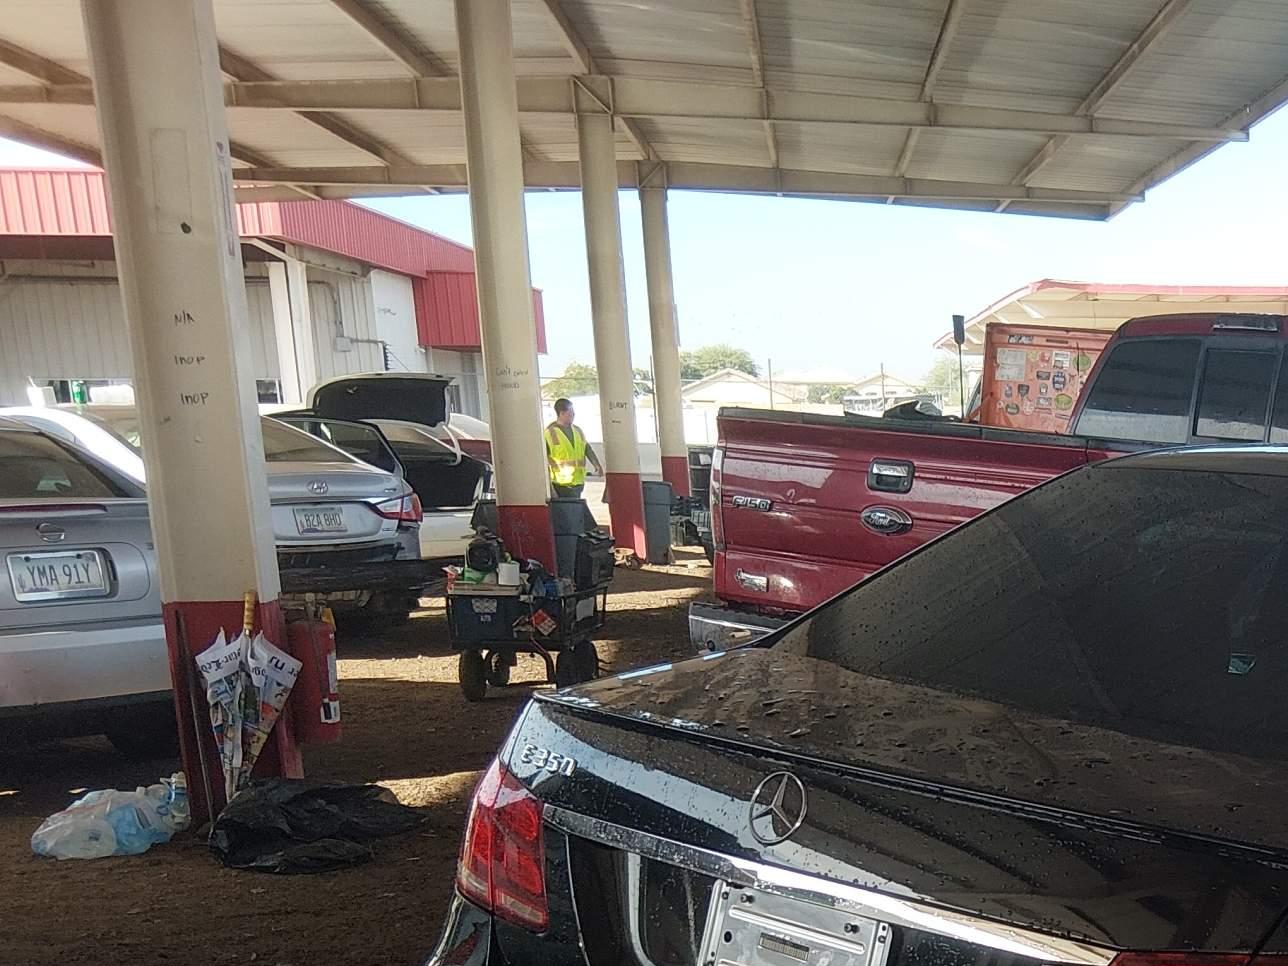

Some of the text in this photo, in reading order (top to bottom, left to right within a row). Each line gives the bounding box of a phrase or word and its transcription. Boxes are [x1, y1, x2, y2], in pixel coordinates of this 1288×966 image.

[26, 562, 91, 587] YMA 91Y
[521, 743, 577, 776] E350
